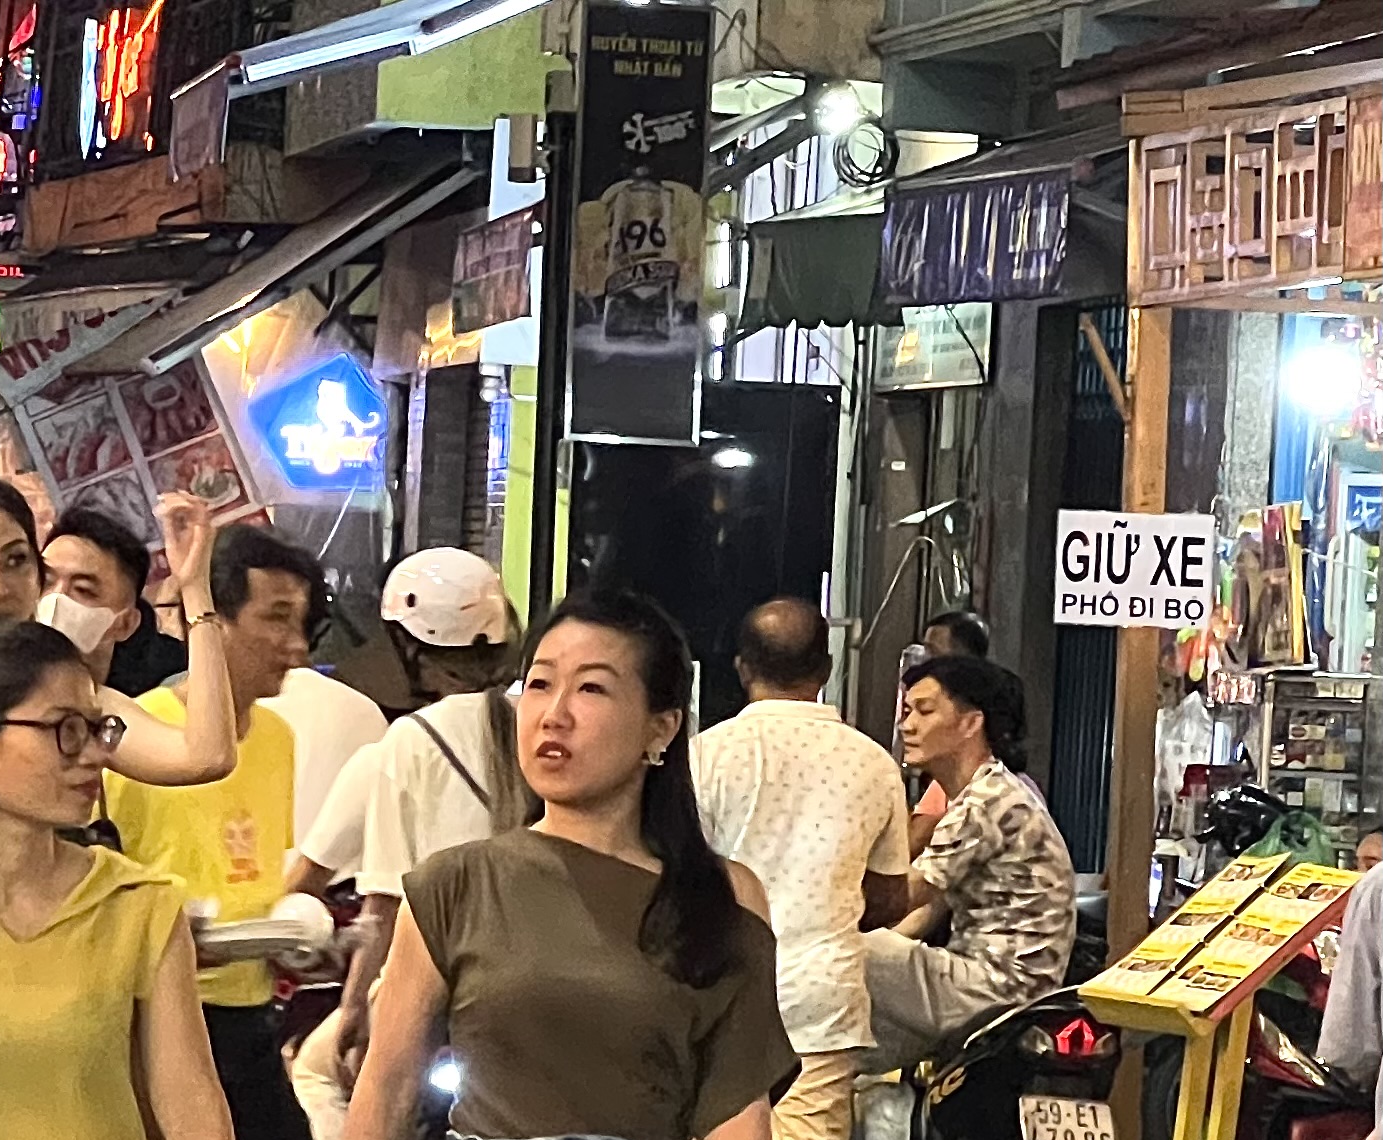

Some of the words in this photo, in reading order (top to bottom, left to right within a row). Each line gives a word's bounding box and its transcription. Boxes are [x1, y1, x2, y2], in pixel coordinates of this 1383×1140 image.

[1062, 520, 1140, 584] GIỮ
[1149, 534, 1206, 588] XE
[1128, 596, 1154, 619] ĐI
[1164, 596, 1204, 626] BỘ
